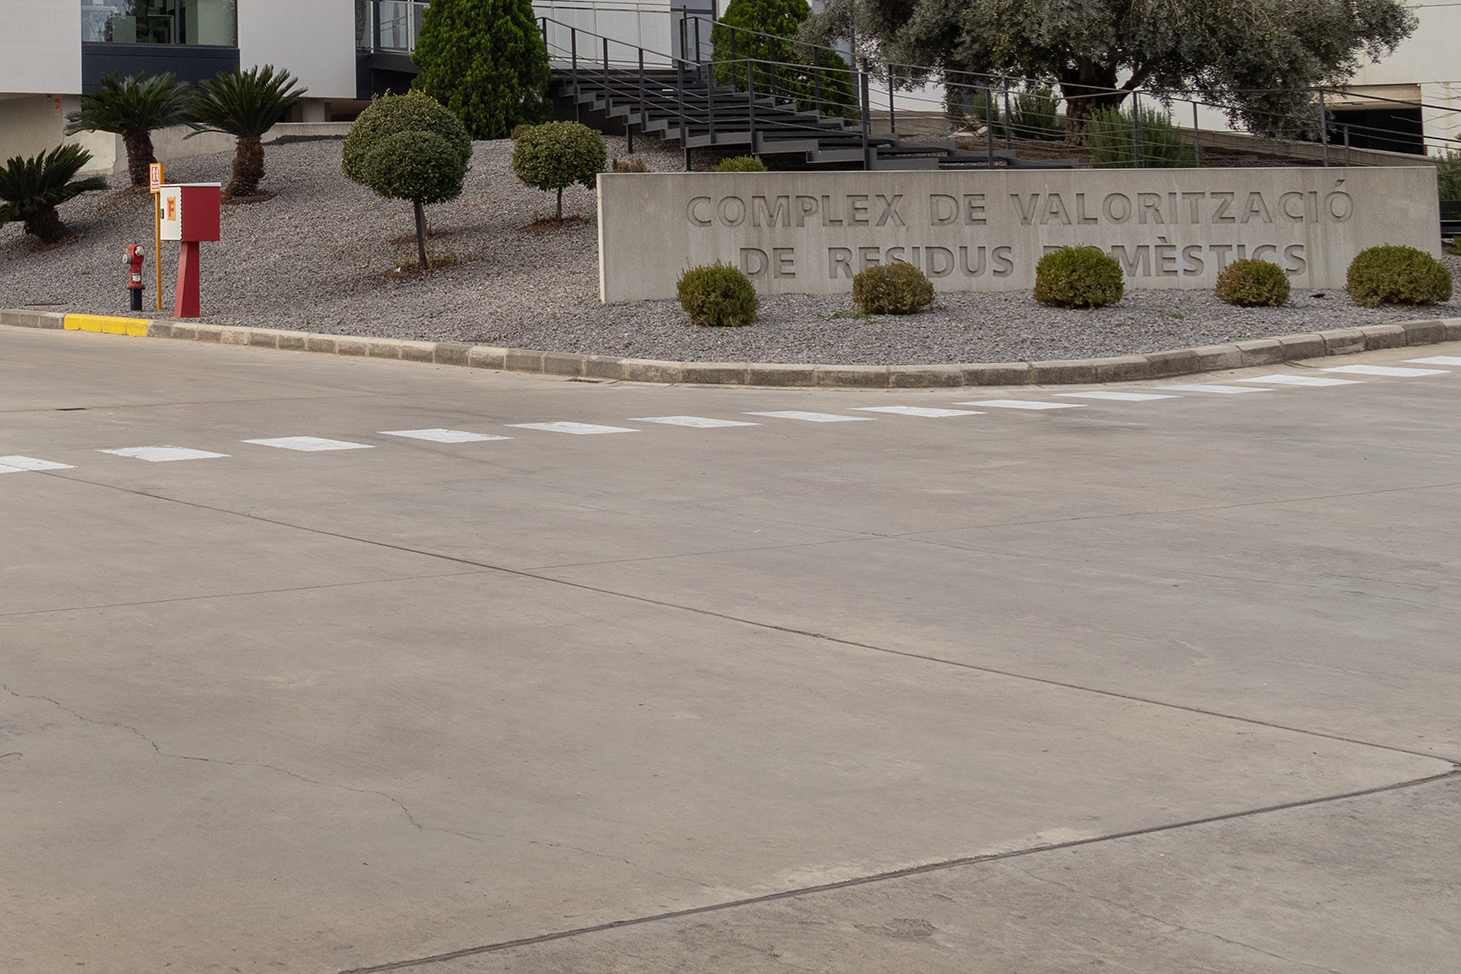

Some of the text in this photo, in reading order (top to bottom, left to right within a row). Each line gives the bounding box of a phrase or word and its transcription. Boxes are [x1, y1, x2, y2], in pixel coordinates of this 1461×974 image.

[686, 179, 1354, 227] COMPLEX DE VALORITZACIÓ
[739, 236, 1307, 279] DE RESIDUS MÈSTS
